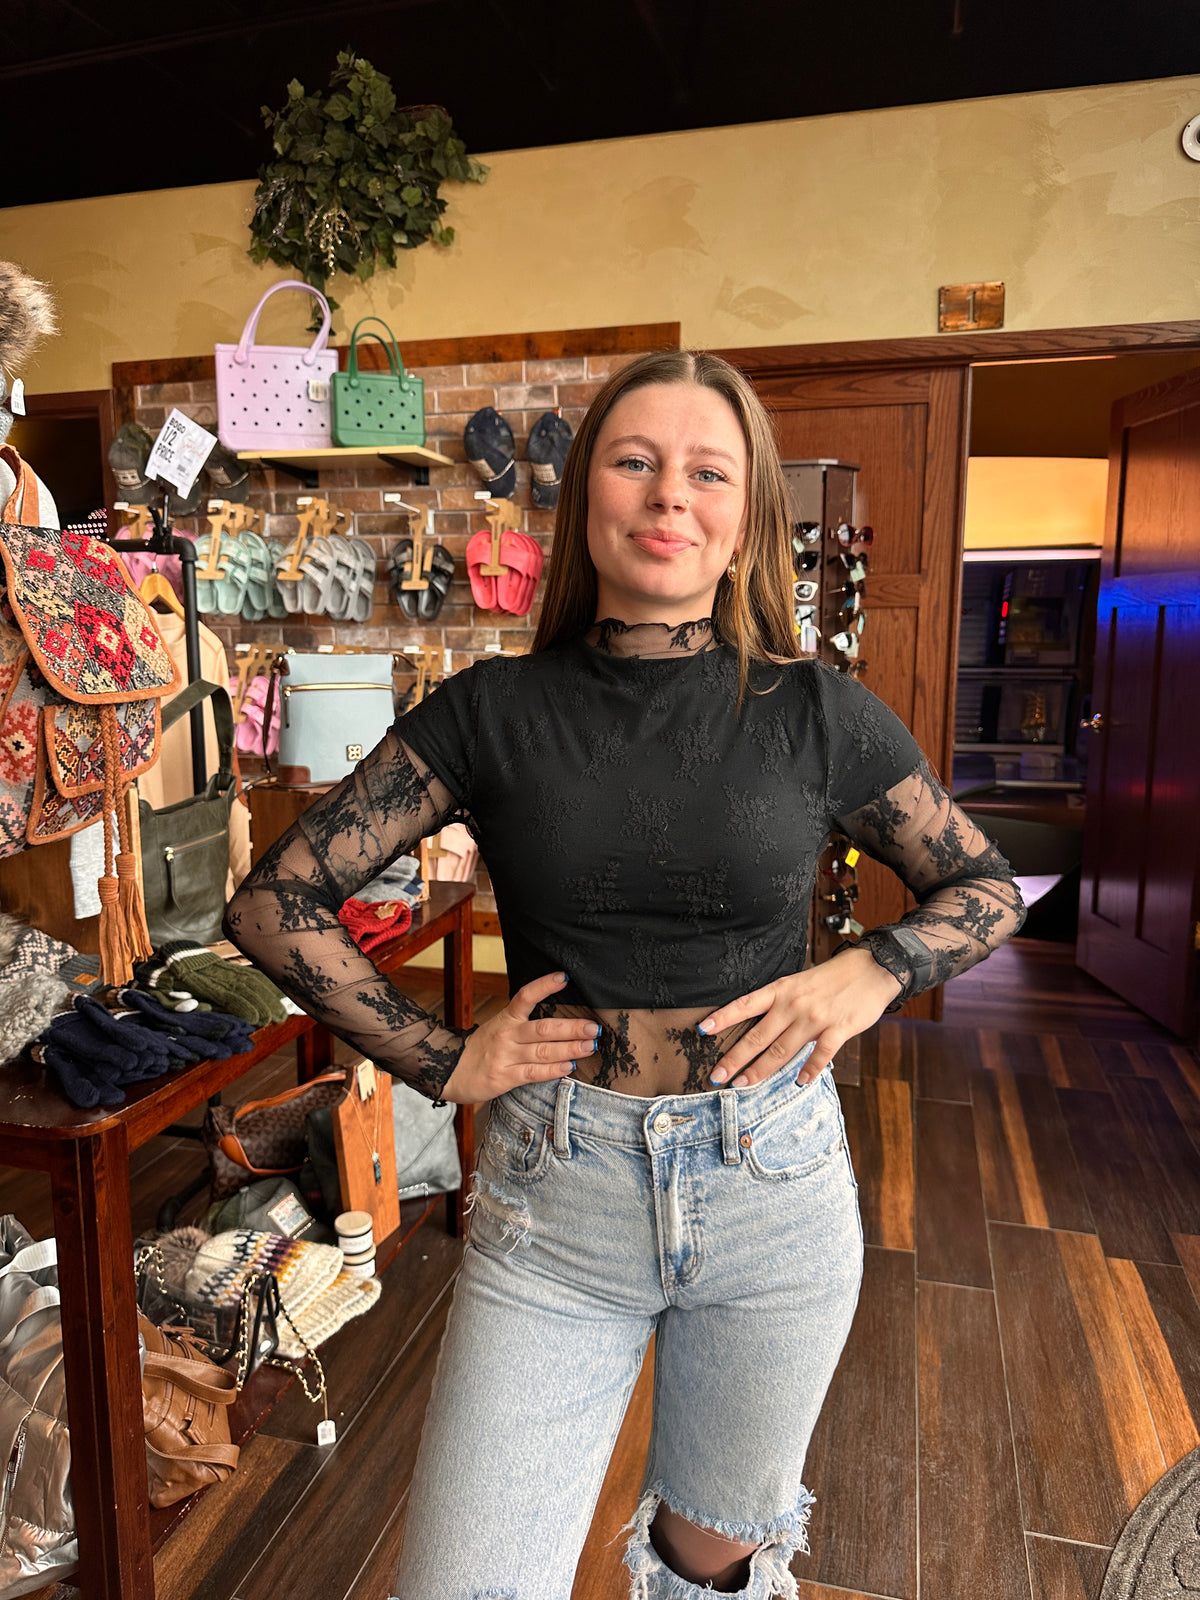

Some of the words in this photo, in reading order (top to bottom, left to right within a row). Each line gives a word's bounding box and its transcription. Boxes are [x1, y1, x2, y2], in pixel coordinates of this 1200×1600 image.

[966, 291, 976, 323] 1
[169, 417, 187, 434] BOGO
[161, 426, 178, 447] 1/2
[155, 443, 175, 463] PRICE
